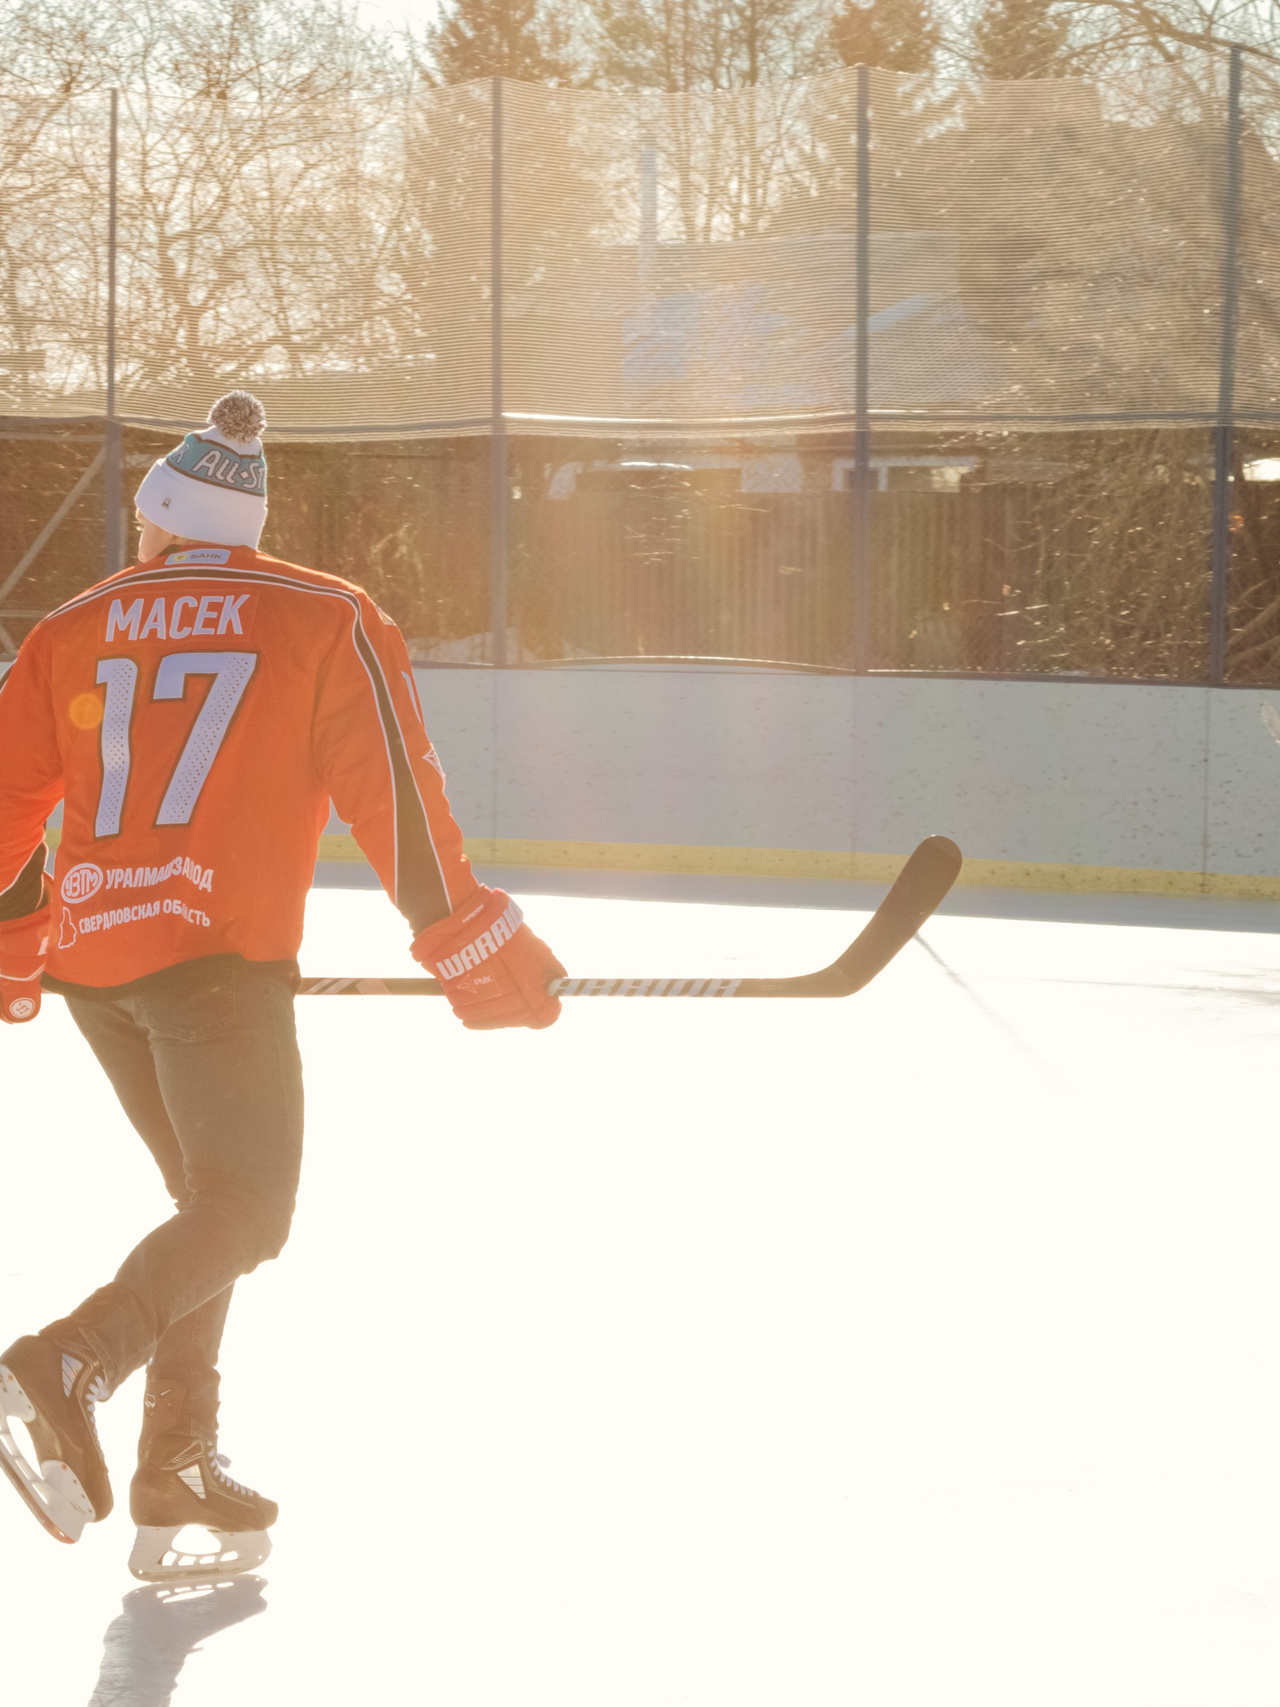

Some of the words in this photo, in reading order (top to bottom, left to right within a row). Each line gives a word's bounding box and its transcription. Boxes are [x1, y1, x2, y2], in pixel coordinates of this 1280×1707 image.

[105, 594, 250, 642] MACEK
[94, 651, 259, 839] 17
[78, 900, 160, 935] СВЕРДЛОВСКАЯ
[547, 978, 744, 998] ARRIOR
